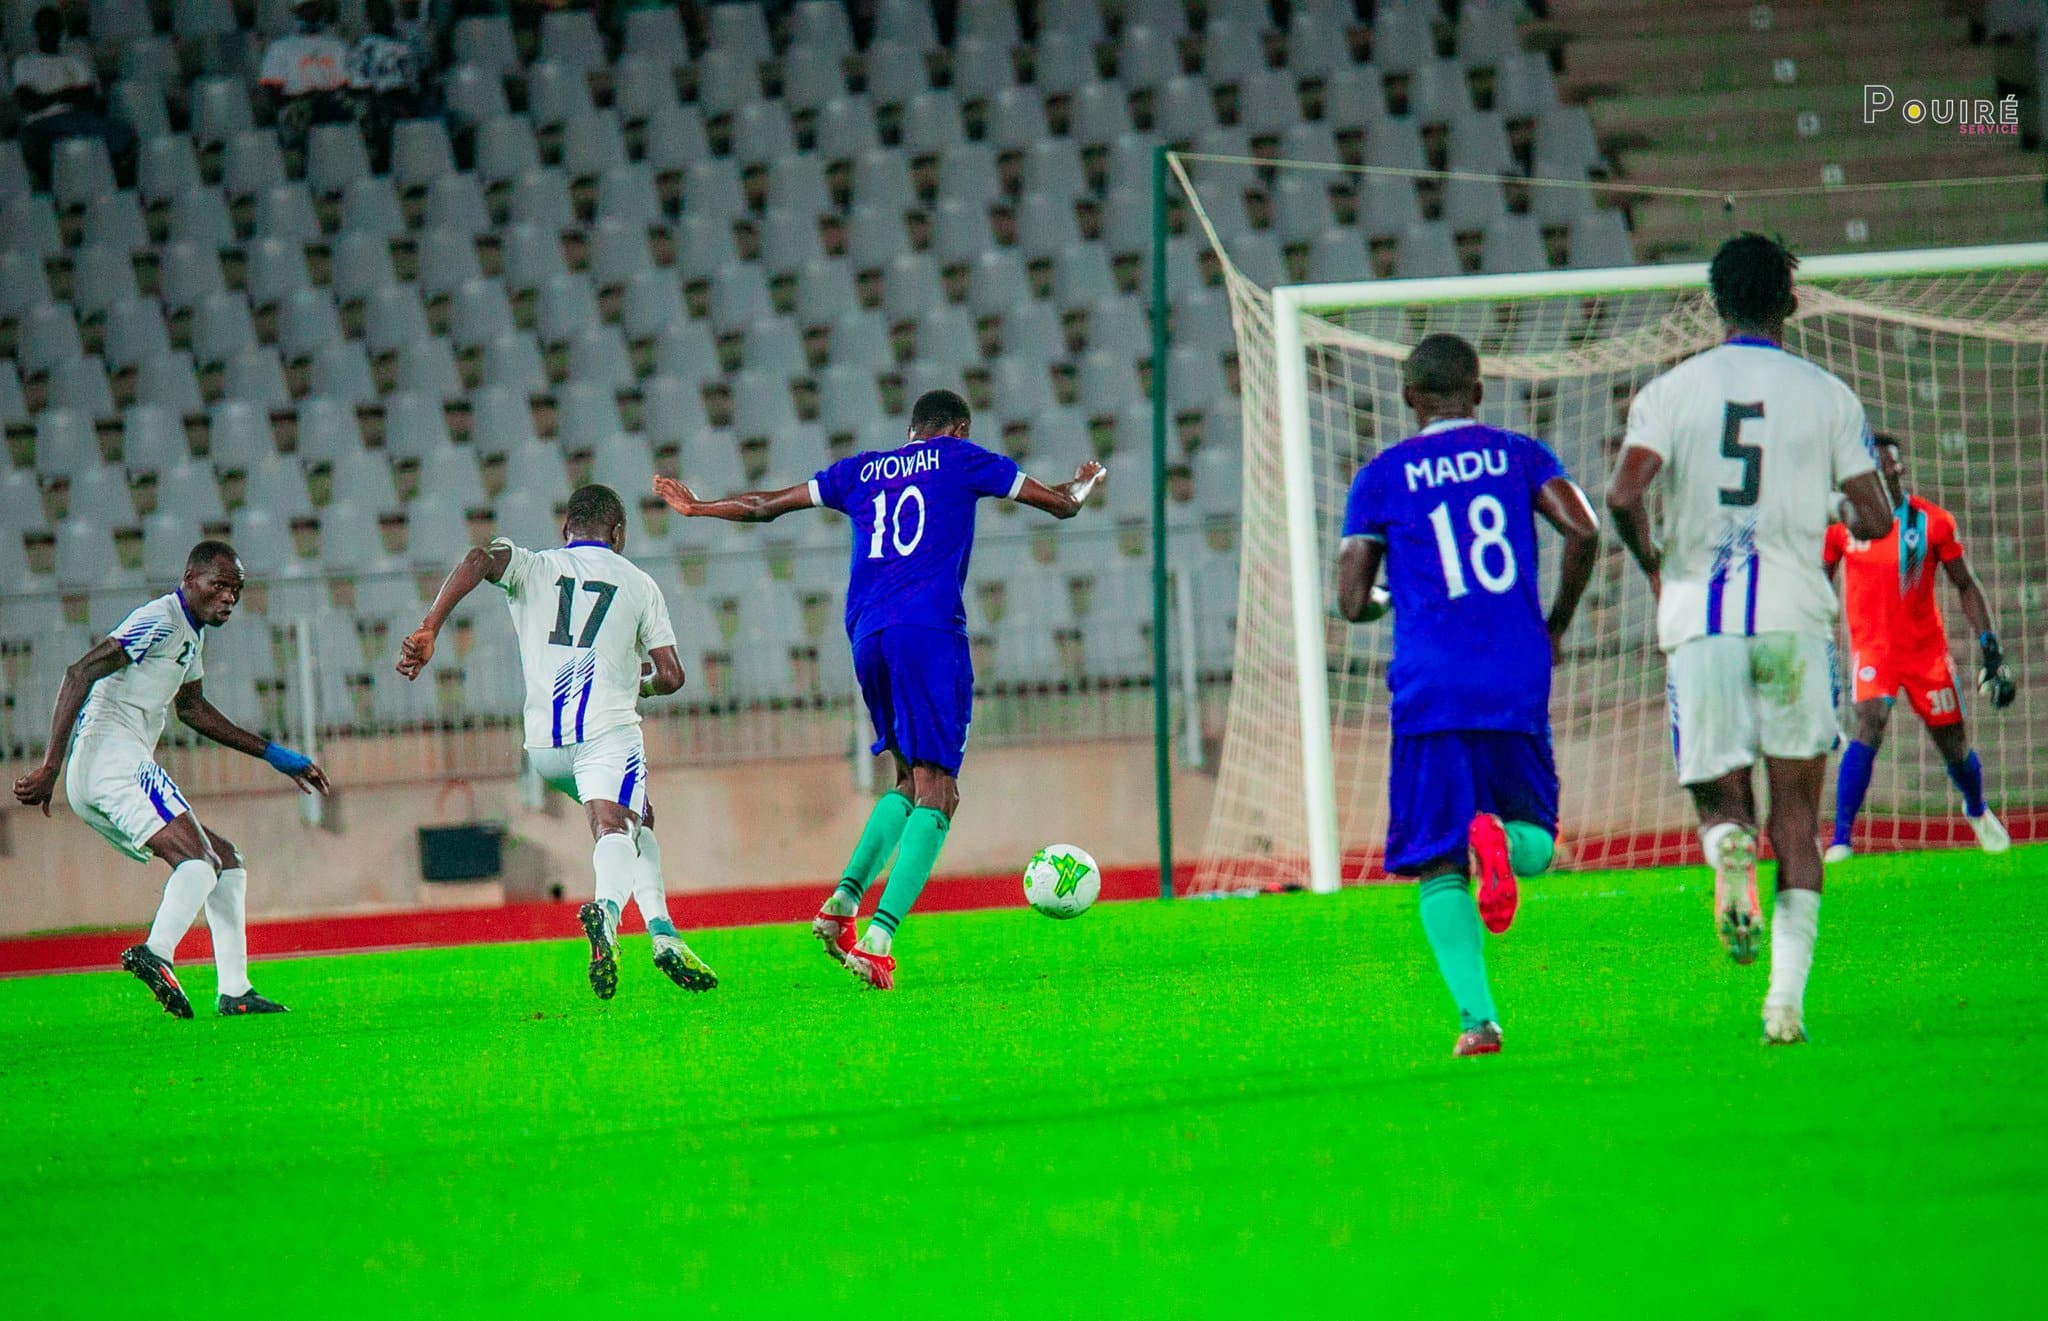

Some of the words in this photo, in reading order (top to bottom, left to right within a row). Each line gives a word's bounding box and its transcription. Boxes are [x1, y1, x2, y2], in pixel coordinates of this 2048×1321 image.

[860, 449, 940, 483] OYOWAH
[1404, 448, 1509, 492] MADU
[1718, 400, 1765, 506] 5
[868, 485, 925, 558] 10
[1428, 494, 1518, 600] 18
[548, 574, 618, 649] 17
